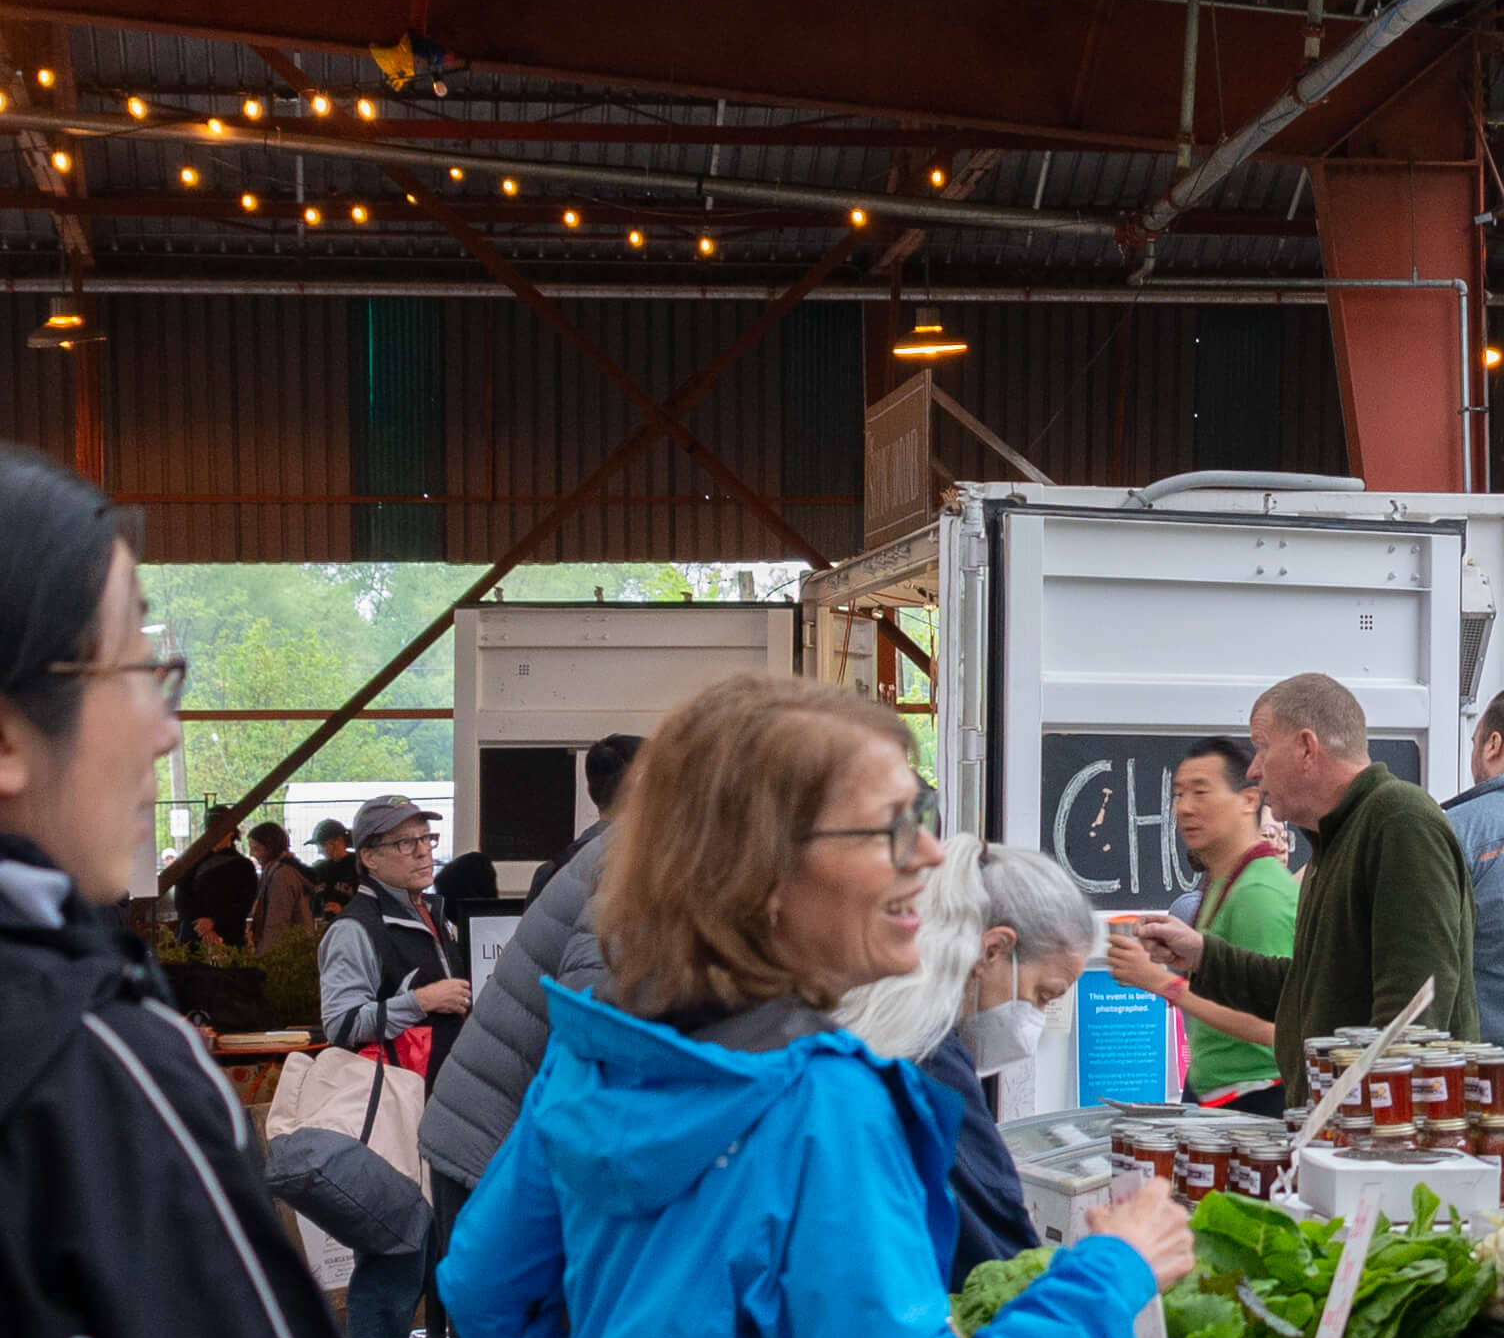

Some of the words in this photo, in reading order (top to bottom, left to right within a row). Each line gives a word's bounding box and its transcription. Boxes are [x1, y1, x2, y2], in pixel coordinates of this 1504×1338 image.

[1089, 993, 1104, 1001] This
[1106, 993, 1127, 1001] event
[1129, 993, 1135, 1001] is
[1136, 993, 1156, 1002] being
